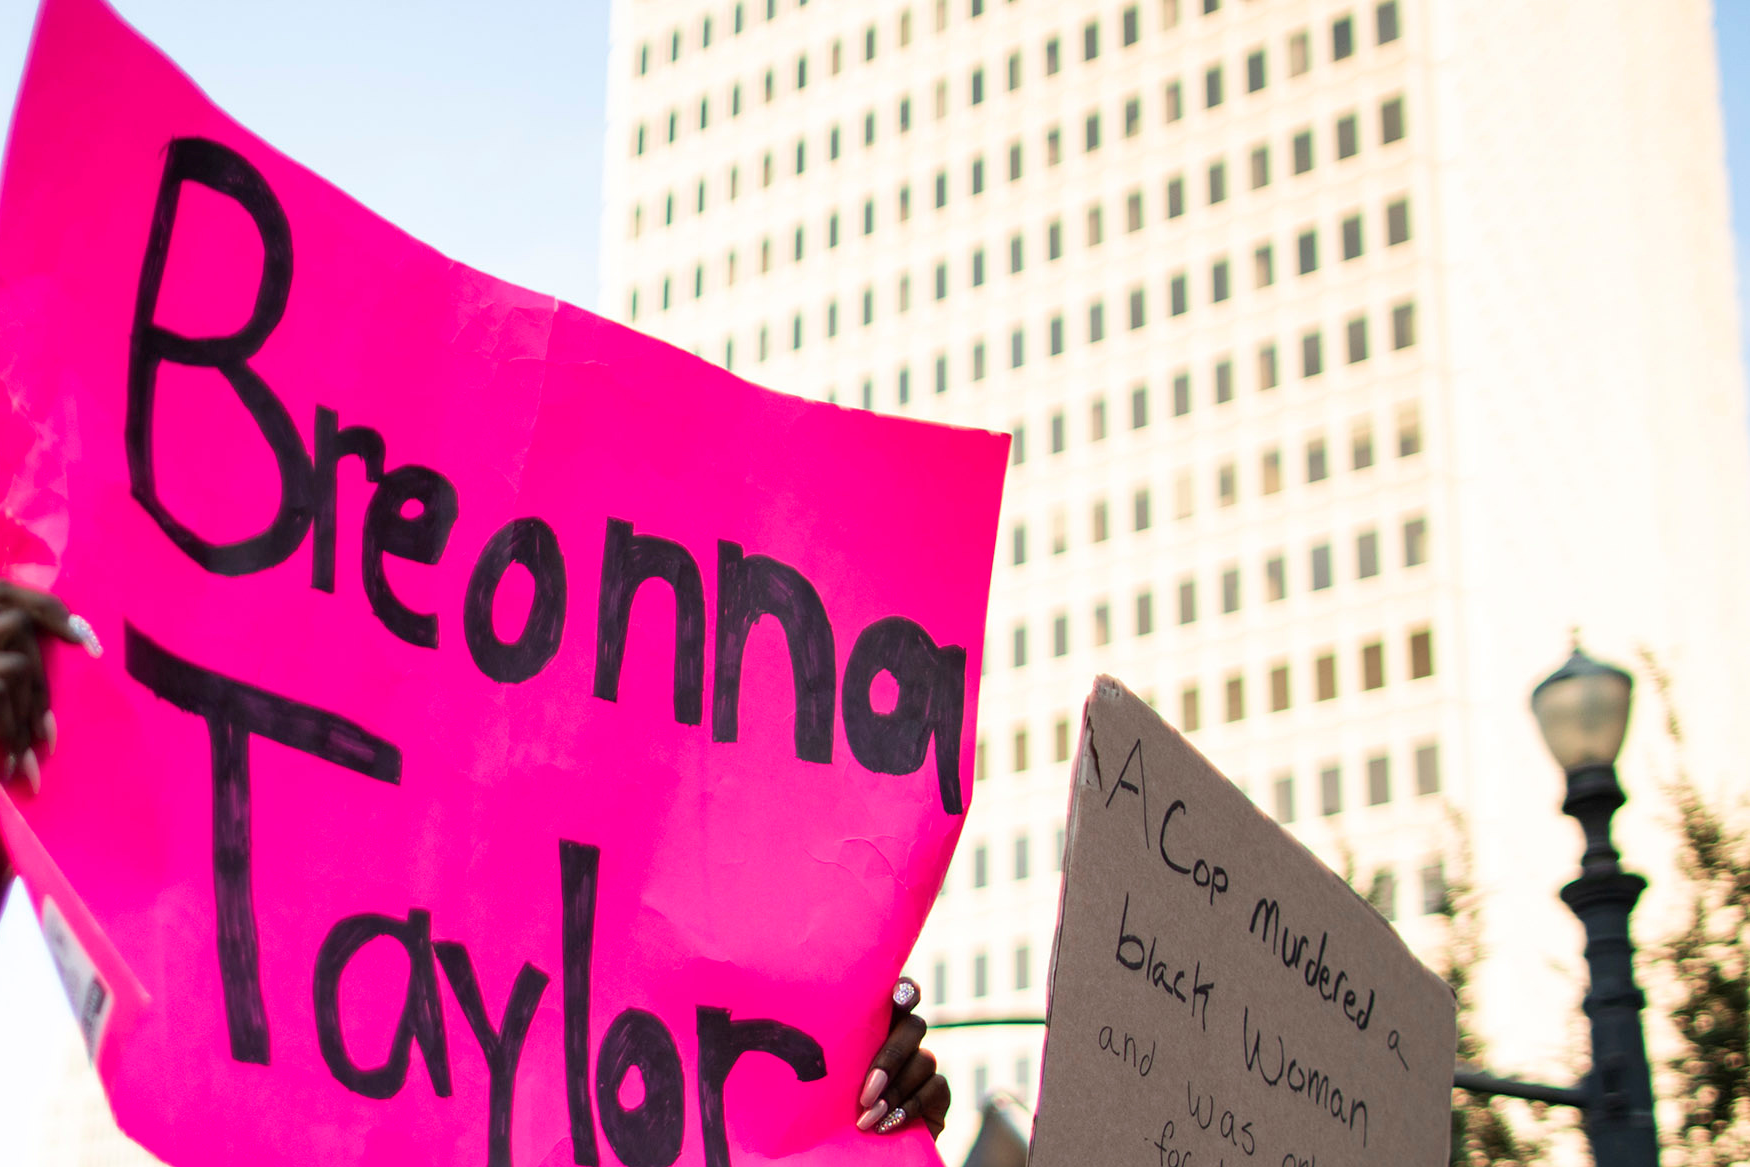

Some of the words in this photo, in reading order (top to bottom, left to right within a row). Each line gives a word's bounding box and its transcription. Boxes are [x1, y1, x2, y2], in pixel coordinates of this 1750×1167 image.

[125, 134, 967, 815] Breonna
[1105, 737, 1151, 851] A
[1159, 799, 1229, 906] Cop
[1386, 1029, 1410, 1073] a
[1115, 891, 1215, 1033] black
[1098, 1025, 1157, 1078] and
